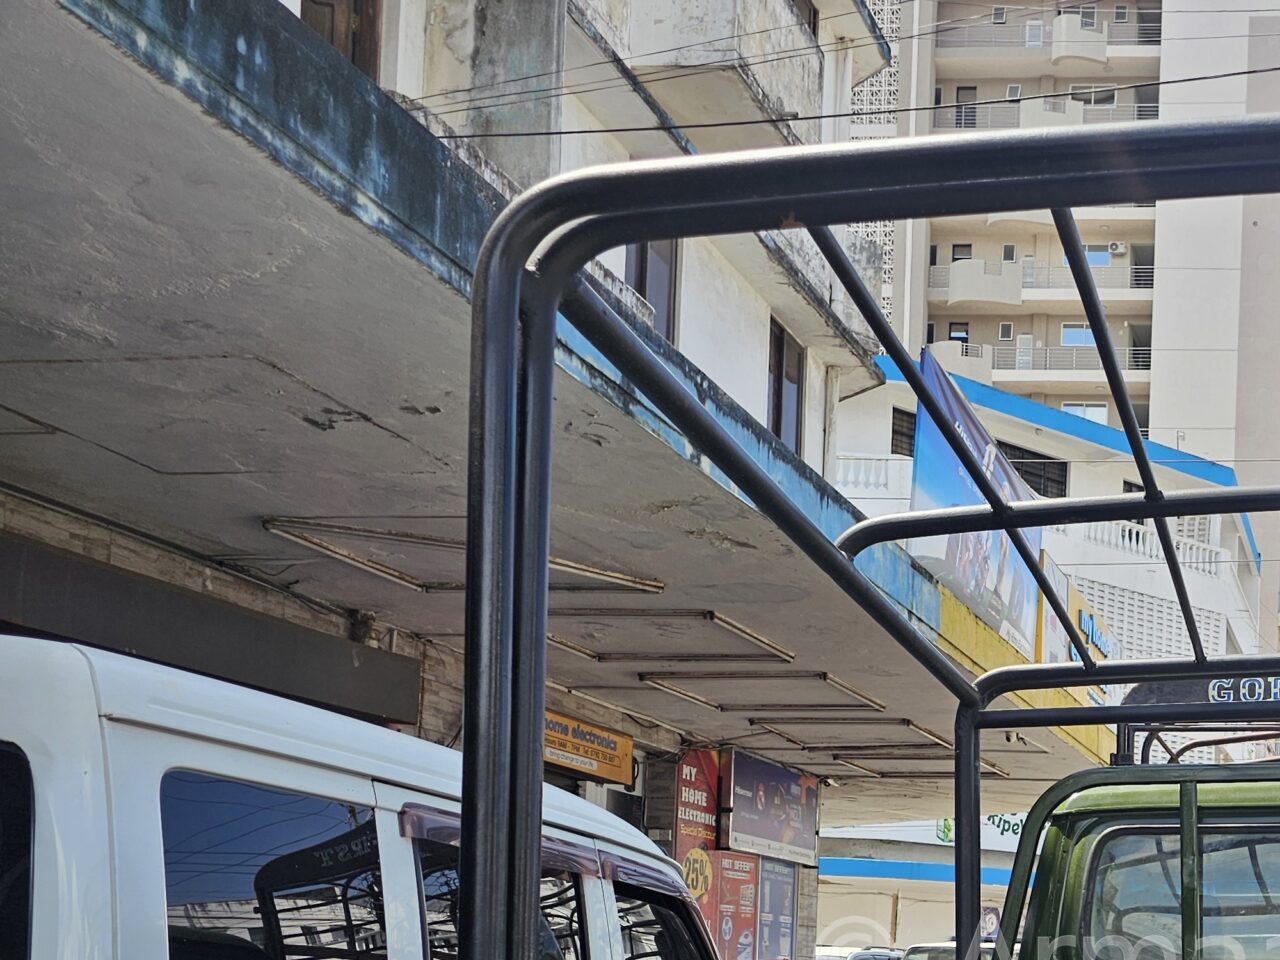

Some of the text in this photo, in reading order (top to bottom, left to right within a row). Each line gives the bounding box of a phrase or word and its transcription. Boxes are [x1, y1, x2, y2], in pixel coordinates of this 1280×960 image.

[571, 723, 618, 752] electronics
[682, 764, 697, 782] MY
[681, 786, 708, 807] HOME
[684, 857, 709, 892] 25%
